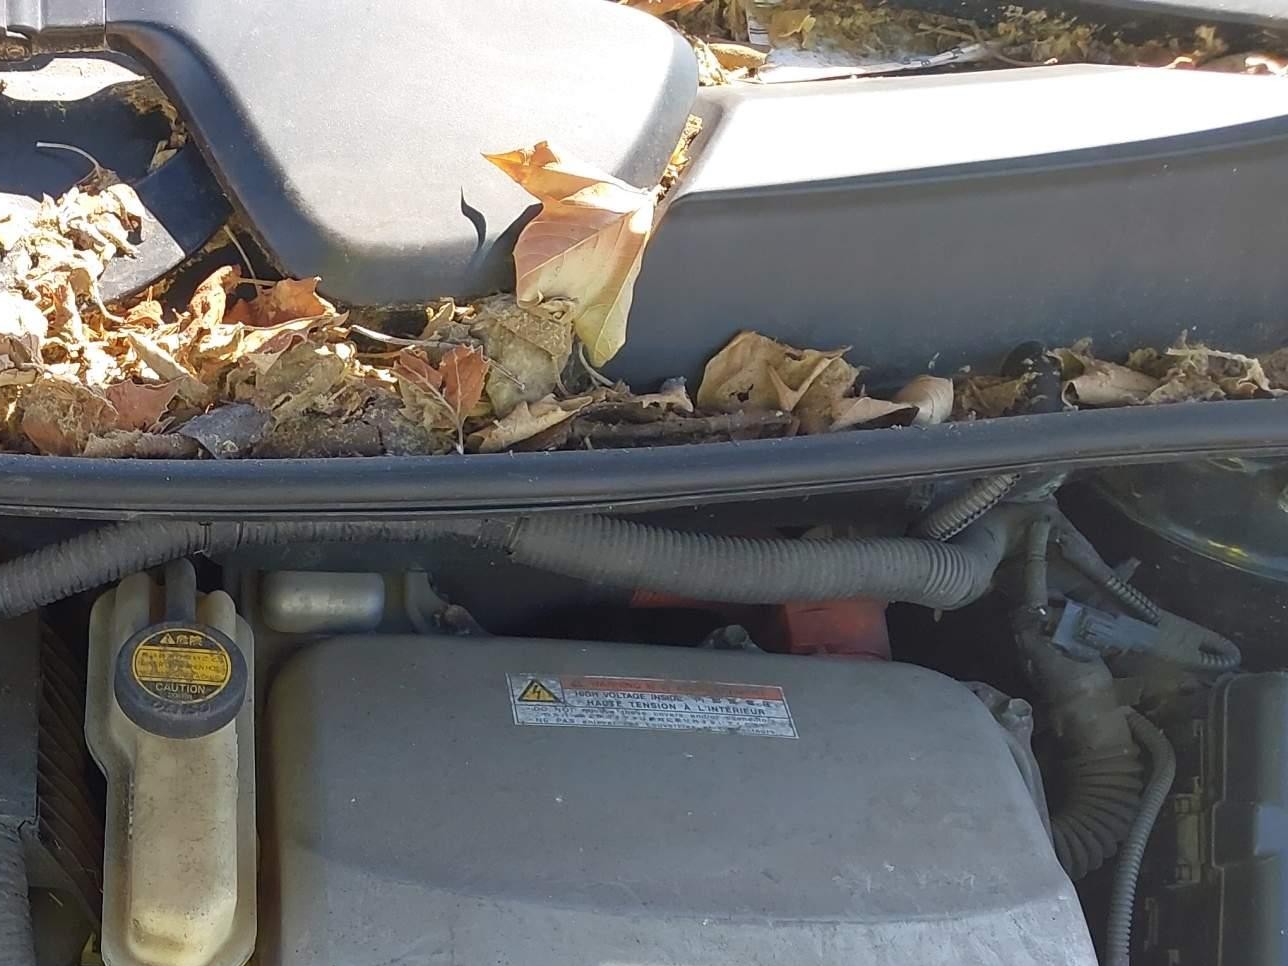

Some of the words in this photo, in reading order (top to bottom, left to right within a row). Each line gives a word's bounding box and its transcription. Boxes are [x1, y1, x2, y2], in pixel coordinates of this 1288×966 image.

[155, 682, 206, 694] CAUTION
[604, 691, 646, 701] VOLTAGE
[631, 701, 677, 711] TENSION
